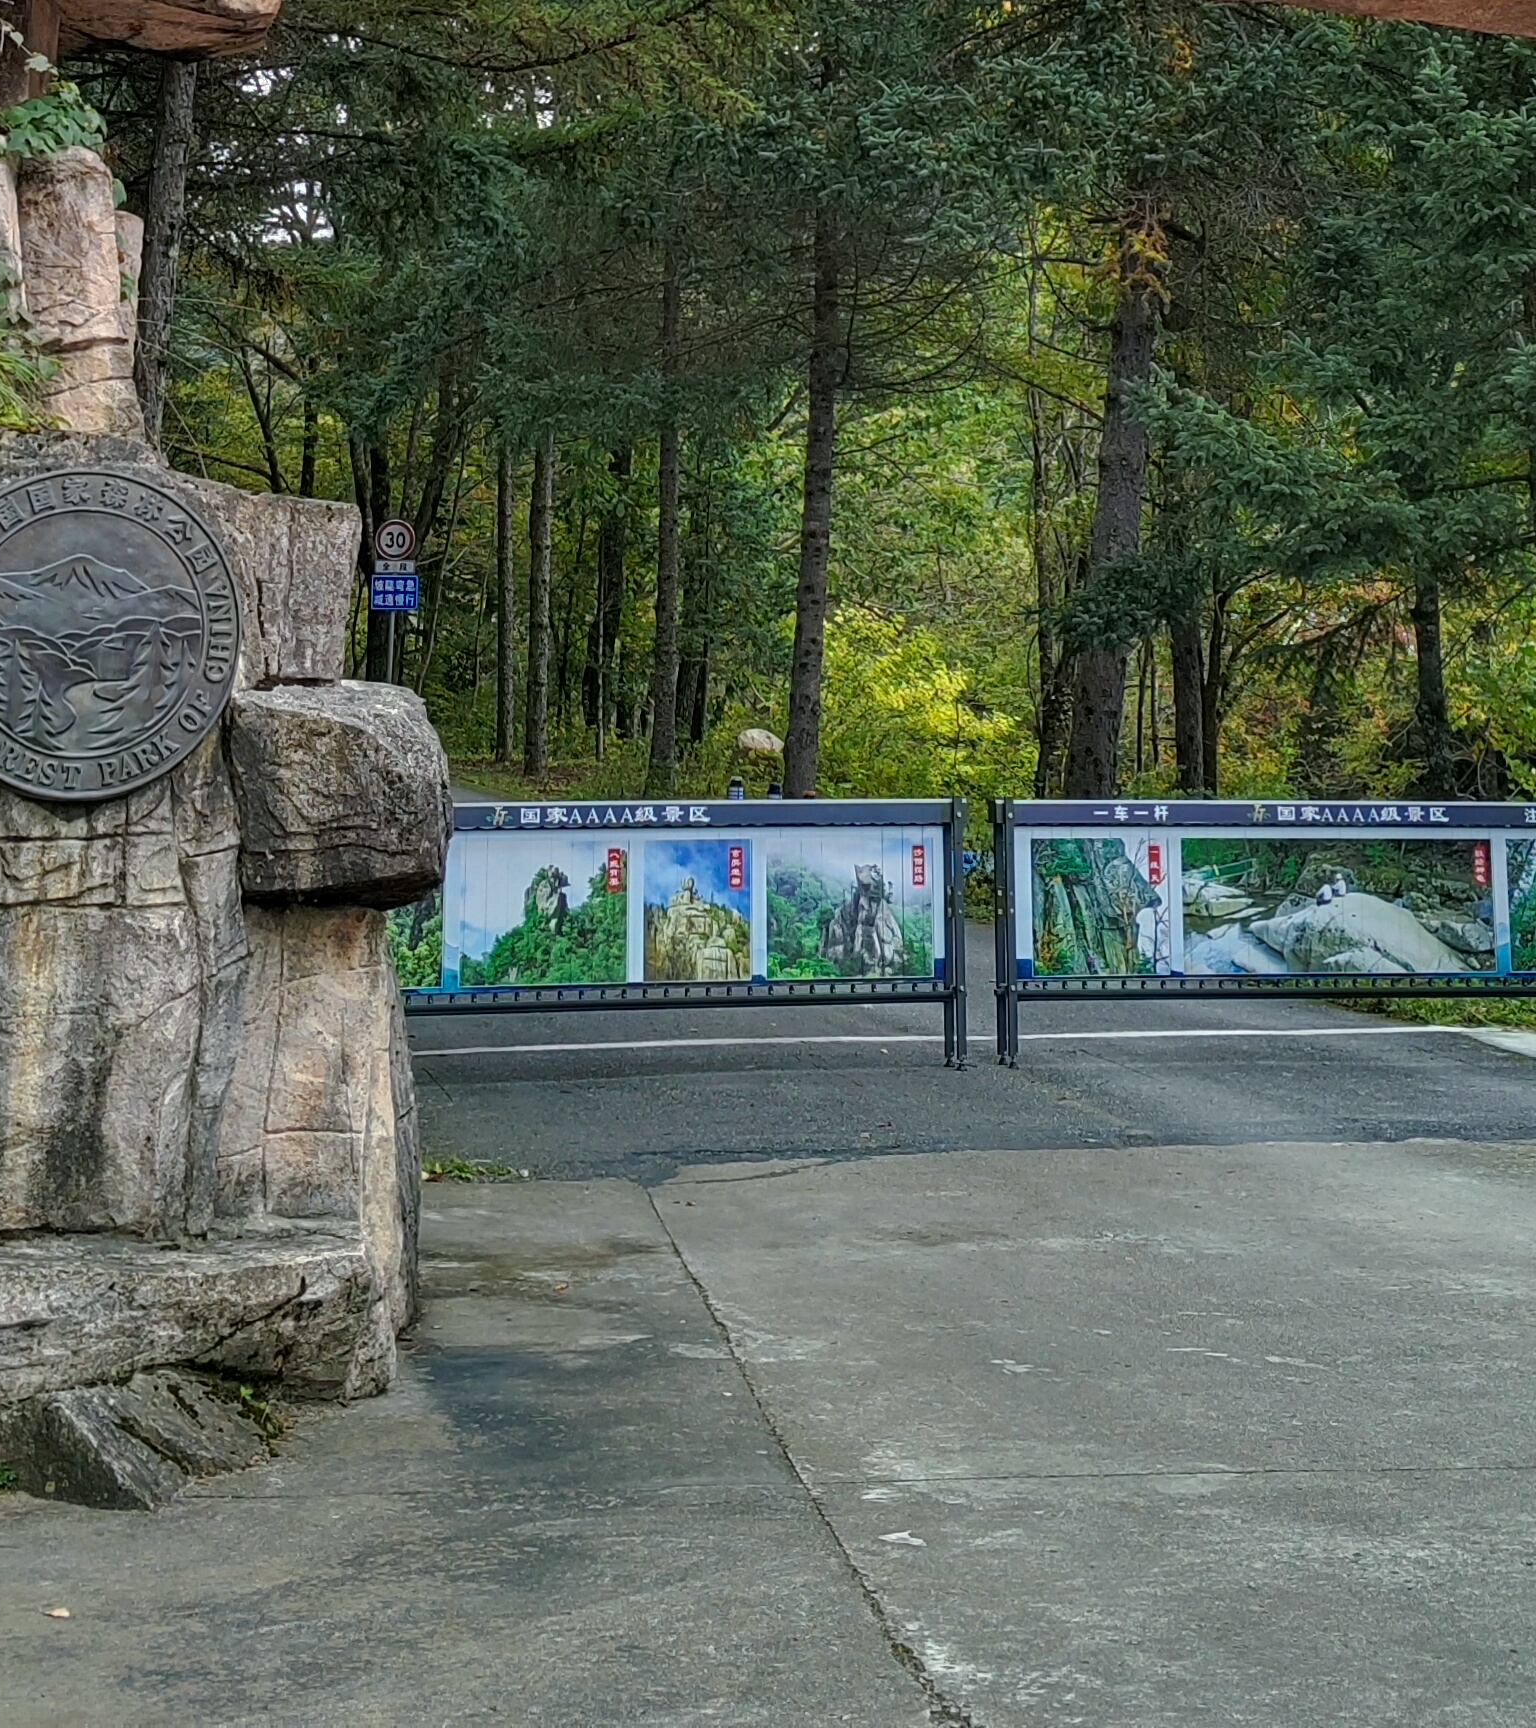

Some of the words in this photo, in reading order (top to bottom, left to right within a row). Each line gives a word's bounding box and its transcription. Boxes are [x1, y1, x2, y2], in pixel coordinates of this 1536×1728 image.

[384, 531, 406, 549] 30
[98, 732, 181, 786] PARK
[178, 688, 213, 732] OF
[204, 583, 234, 684] CHINA
[519, 805, 712, 825] 国家AAAA级景区
[1093, 804, 1170, 822] 一车一杆
[1276, 805, 1450, 823] 国家AAAA级景区
